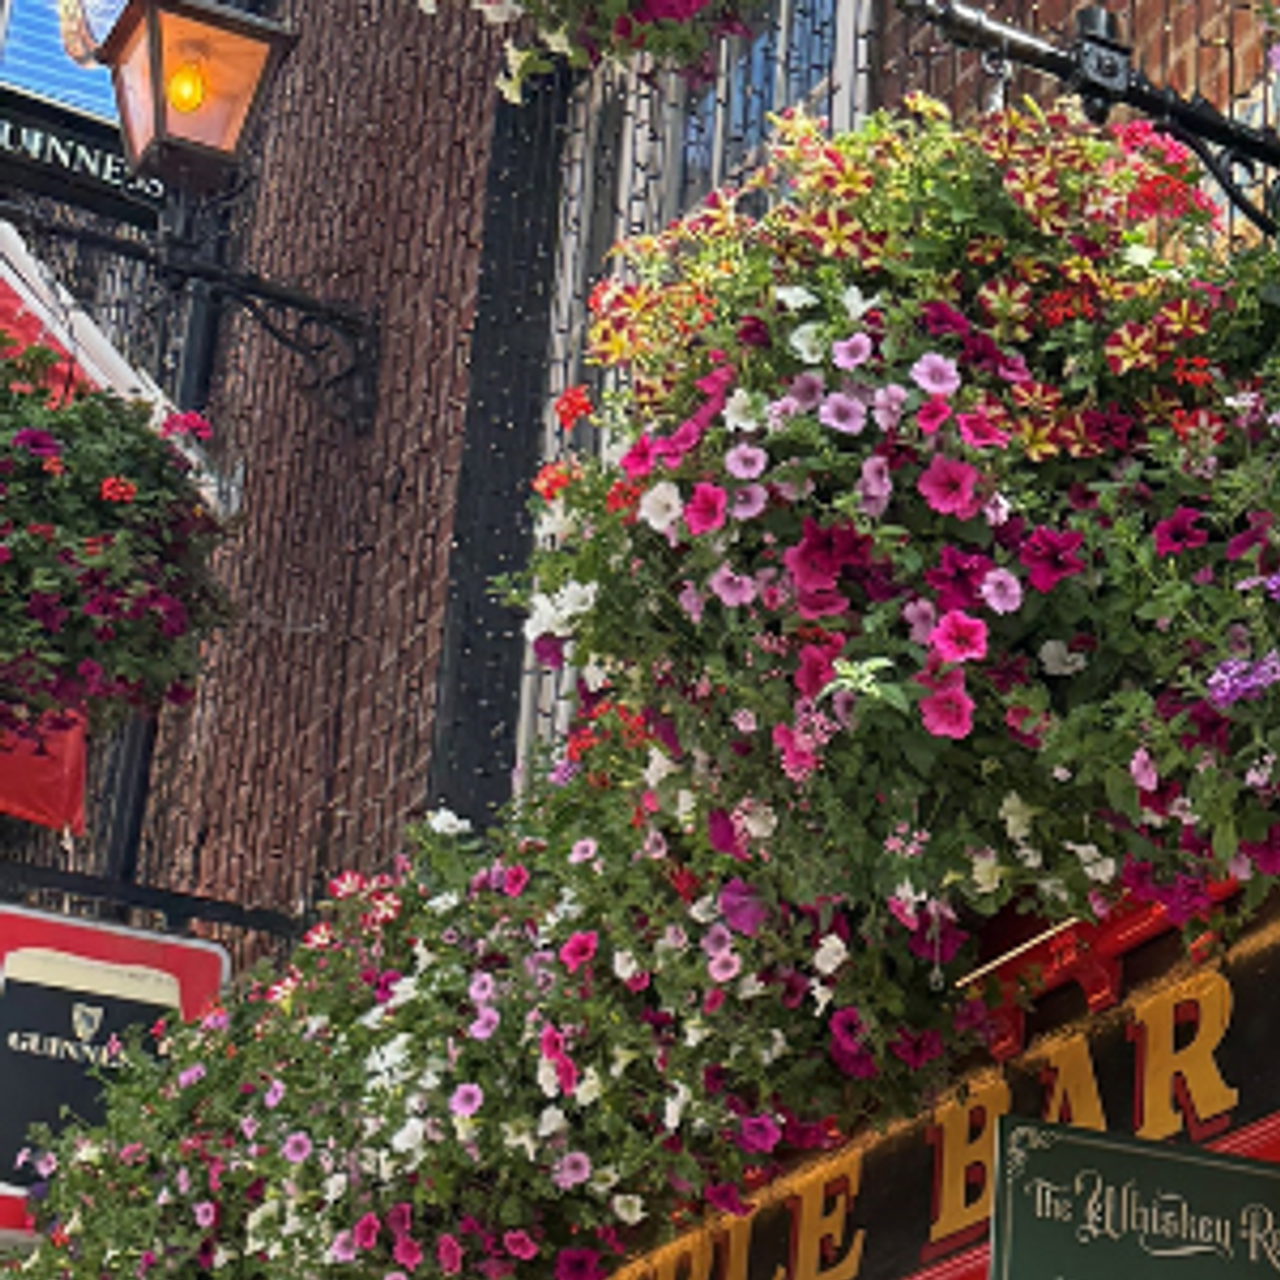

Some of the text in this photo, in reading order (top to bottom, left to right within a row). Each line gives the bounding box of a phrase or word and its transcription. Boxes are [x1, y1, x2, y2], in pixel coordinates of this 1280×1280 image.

[927, 967, 1239, 1248] BAR
[1024, 1177, 1073, 1222] The
[1075, 1168, 1235, 1260] Whiskey
